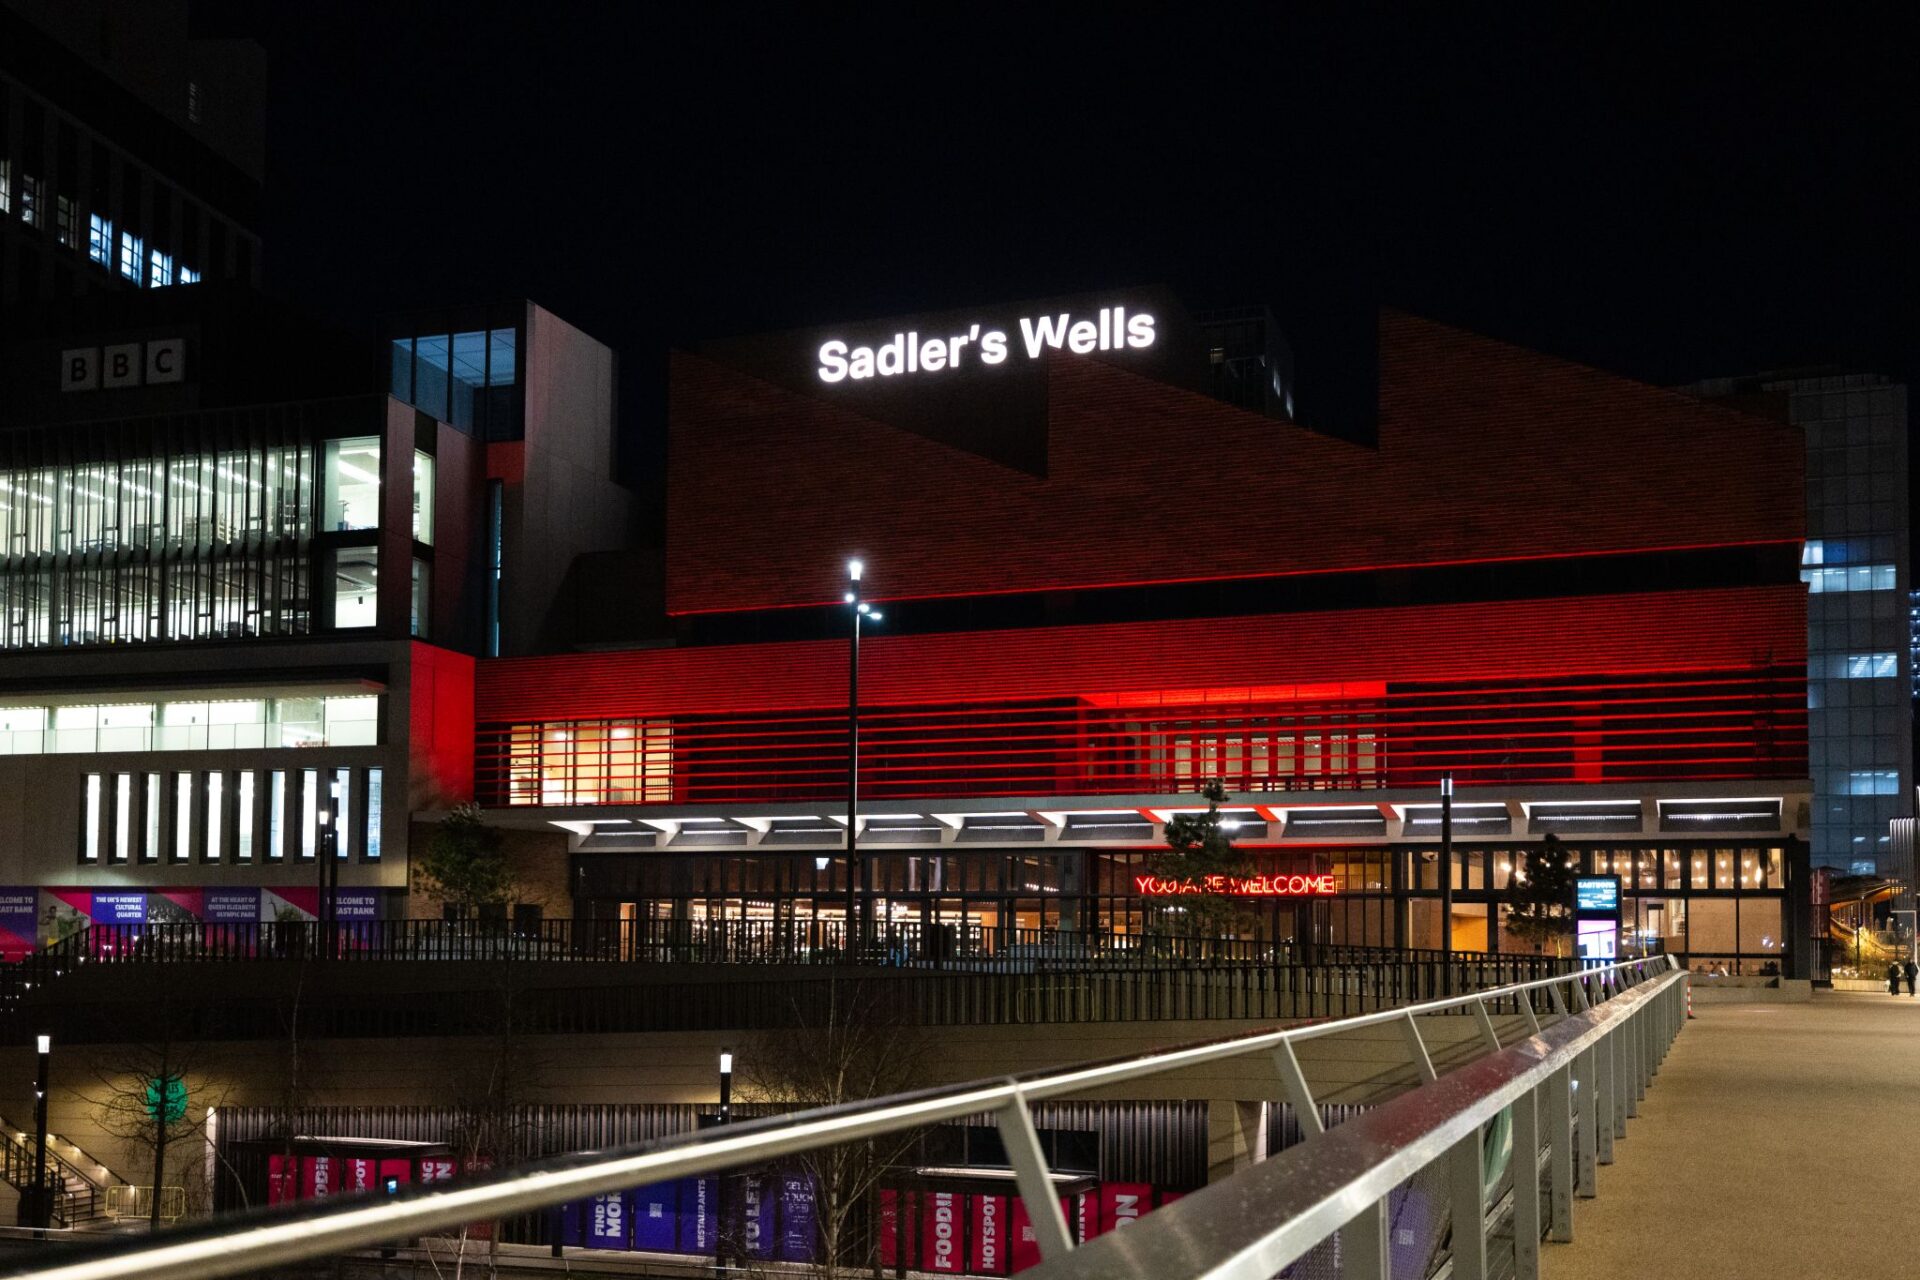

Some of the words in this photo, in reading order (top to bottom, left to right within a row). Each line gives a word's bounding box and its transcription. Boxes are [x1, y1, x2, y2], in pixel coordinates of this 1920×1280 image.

[818, 325, 1008, 383] Sadler's
[1019, 307, 1156, 359] Wells
[70, 348, 173, 383] BBC
[1136, 877, 1178, 893] YOU
[1230, 875, 1335, 893] WELCOME
[116, 911, 142, 919] QUARTER
[595, 1204, 605, 1236] FIND
[982, 1195, 996, 1269] HOTSPOT
